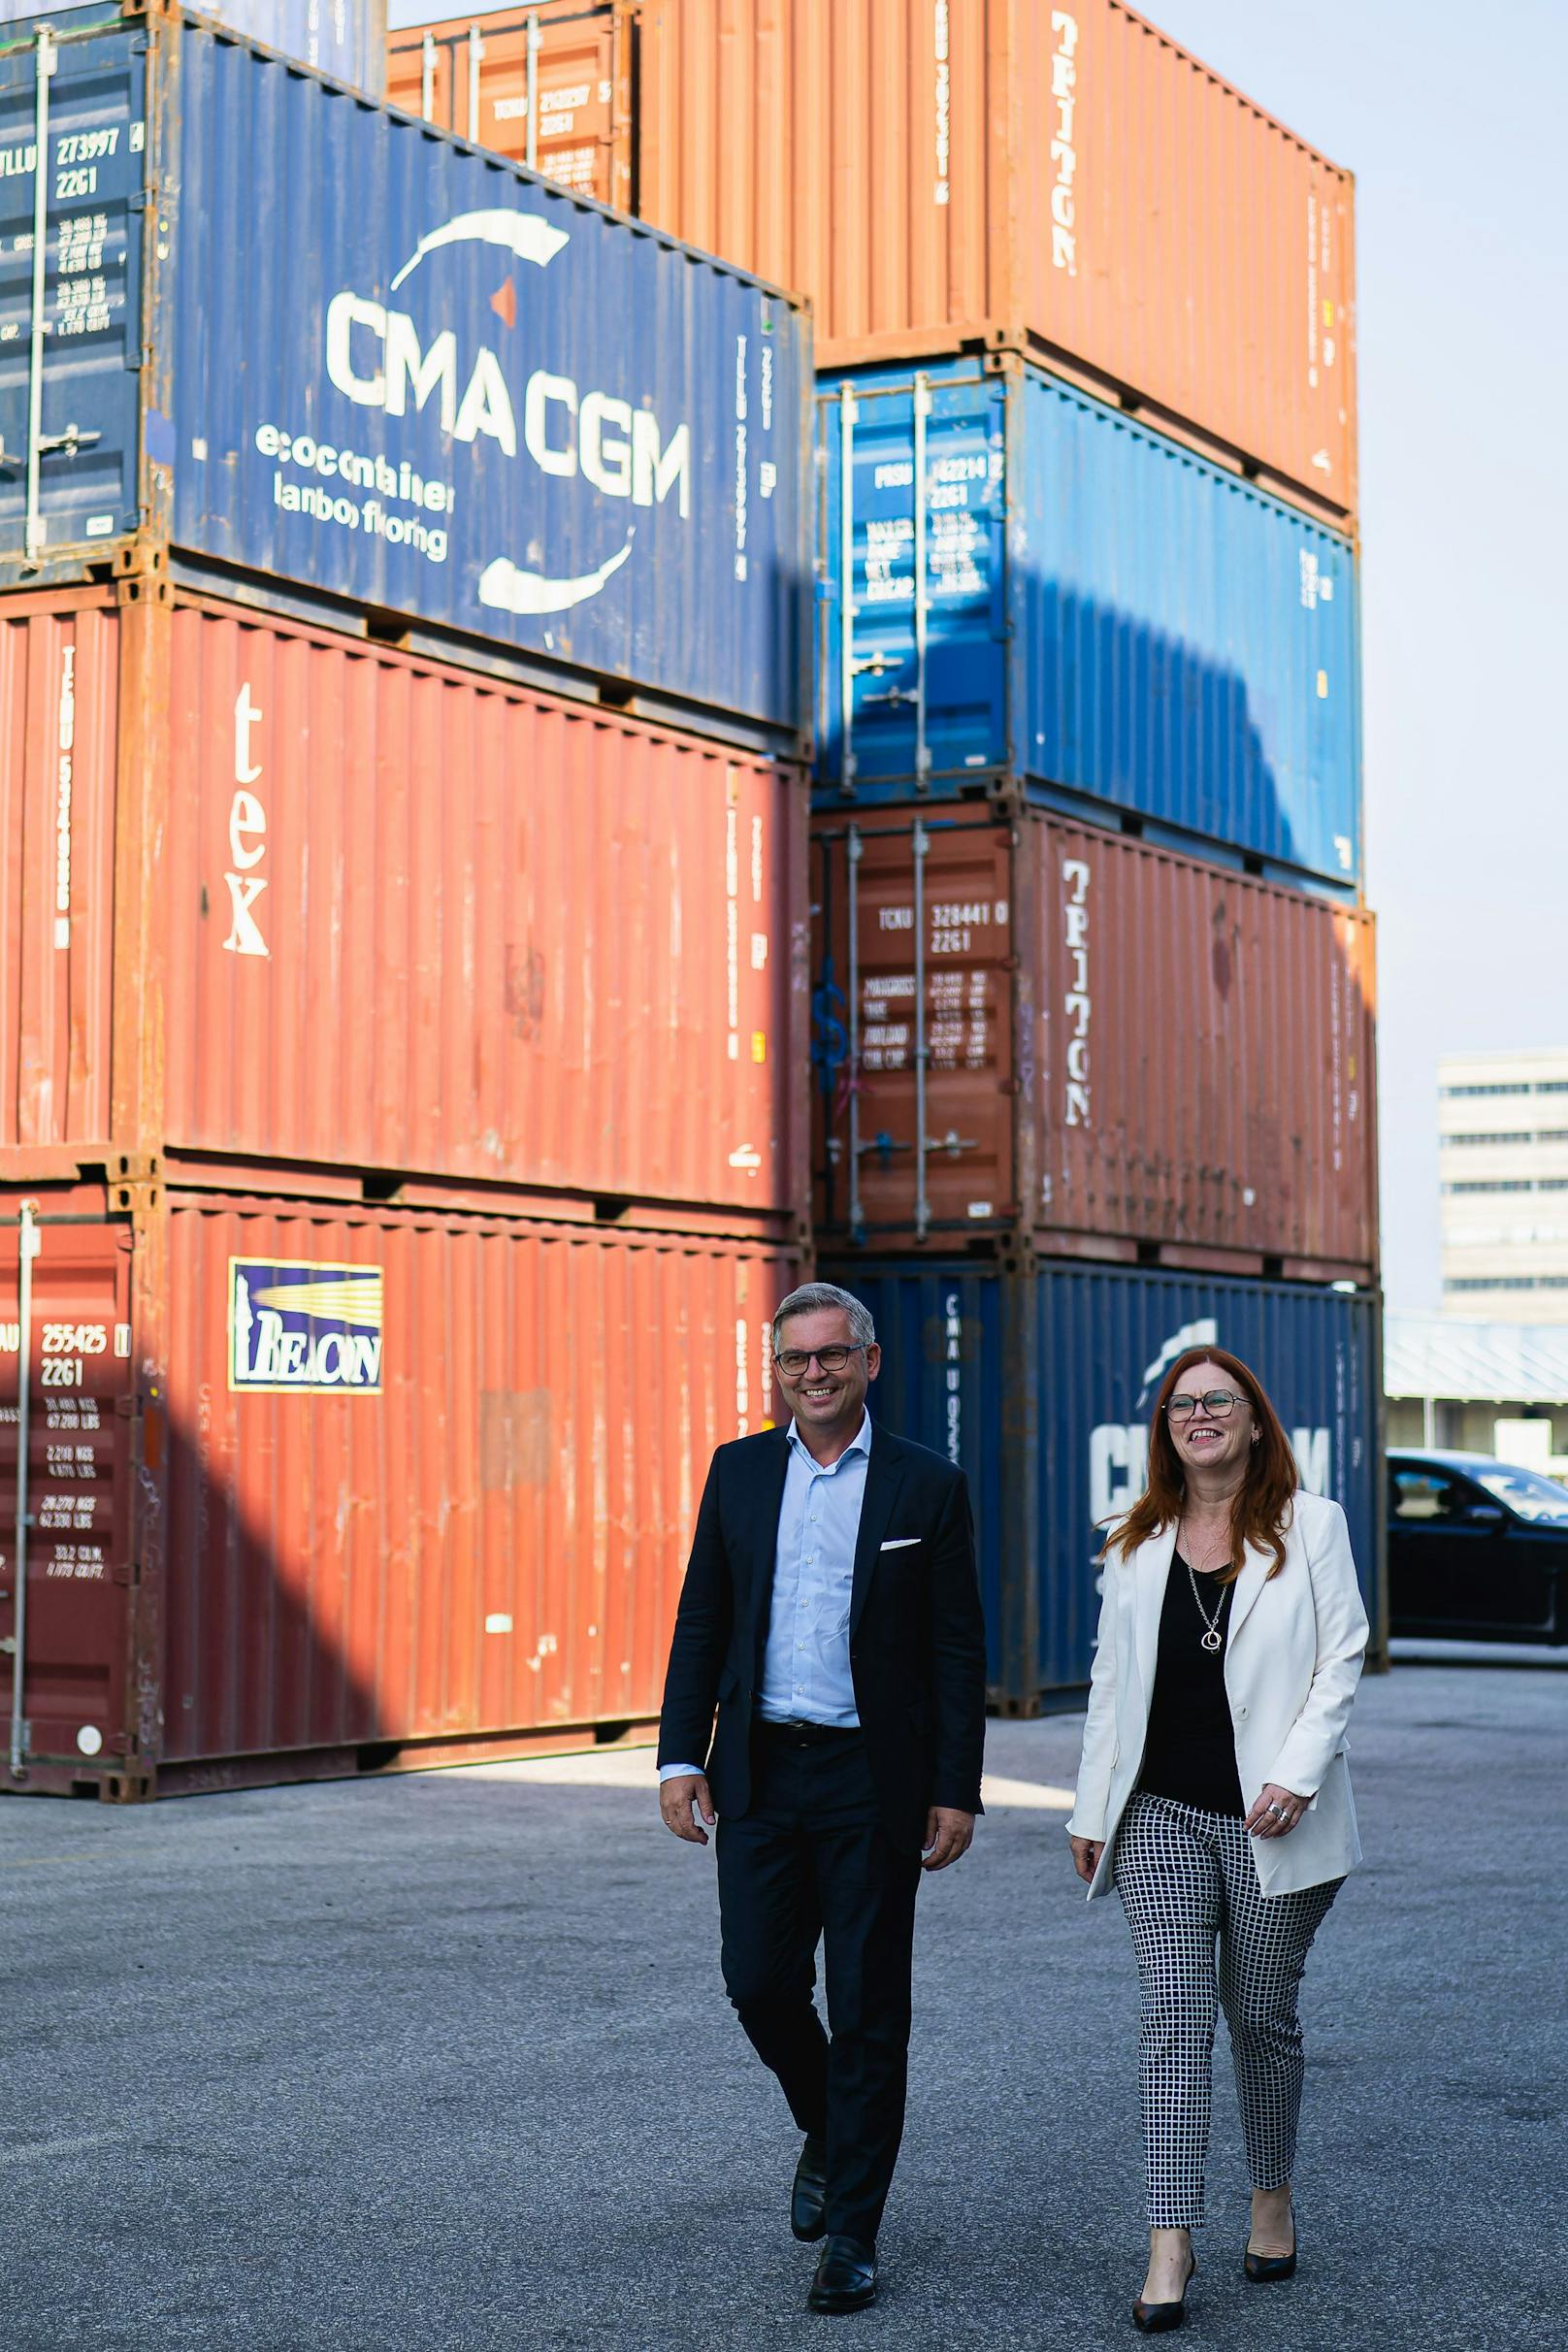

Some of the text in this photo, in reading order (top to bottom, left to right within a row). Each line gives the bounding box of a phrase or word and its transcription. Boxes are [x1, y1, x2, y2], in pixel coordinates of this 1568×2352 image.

[56, 127, 119, 165] 273997
[55, 166, 97, 199] 22G1
[326, 291, 690, 519] CMA CGM
[223, 681, 270, 957] tex
[41, 1323, 108, 1355] 255425
[946, 1292, 962, 1360] CMA
[41, 1357, 83, 1387] 22G1
[735, 1319, 749, 1414] BEAU
[761, 1321, 773, 1414] 22G1
[947, 1368, 960, 1391] U
